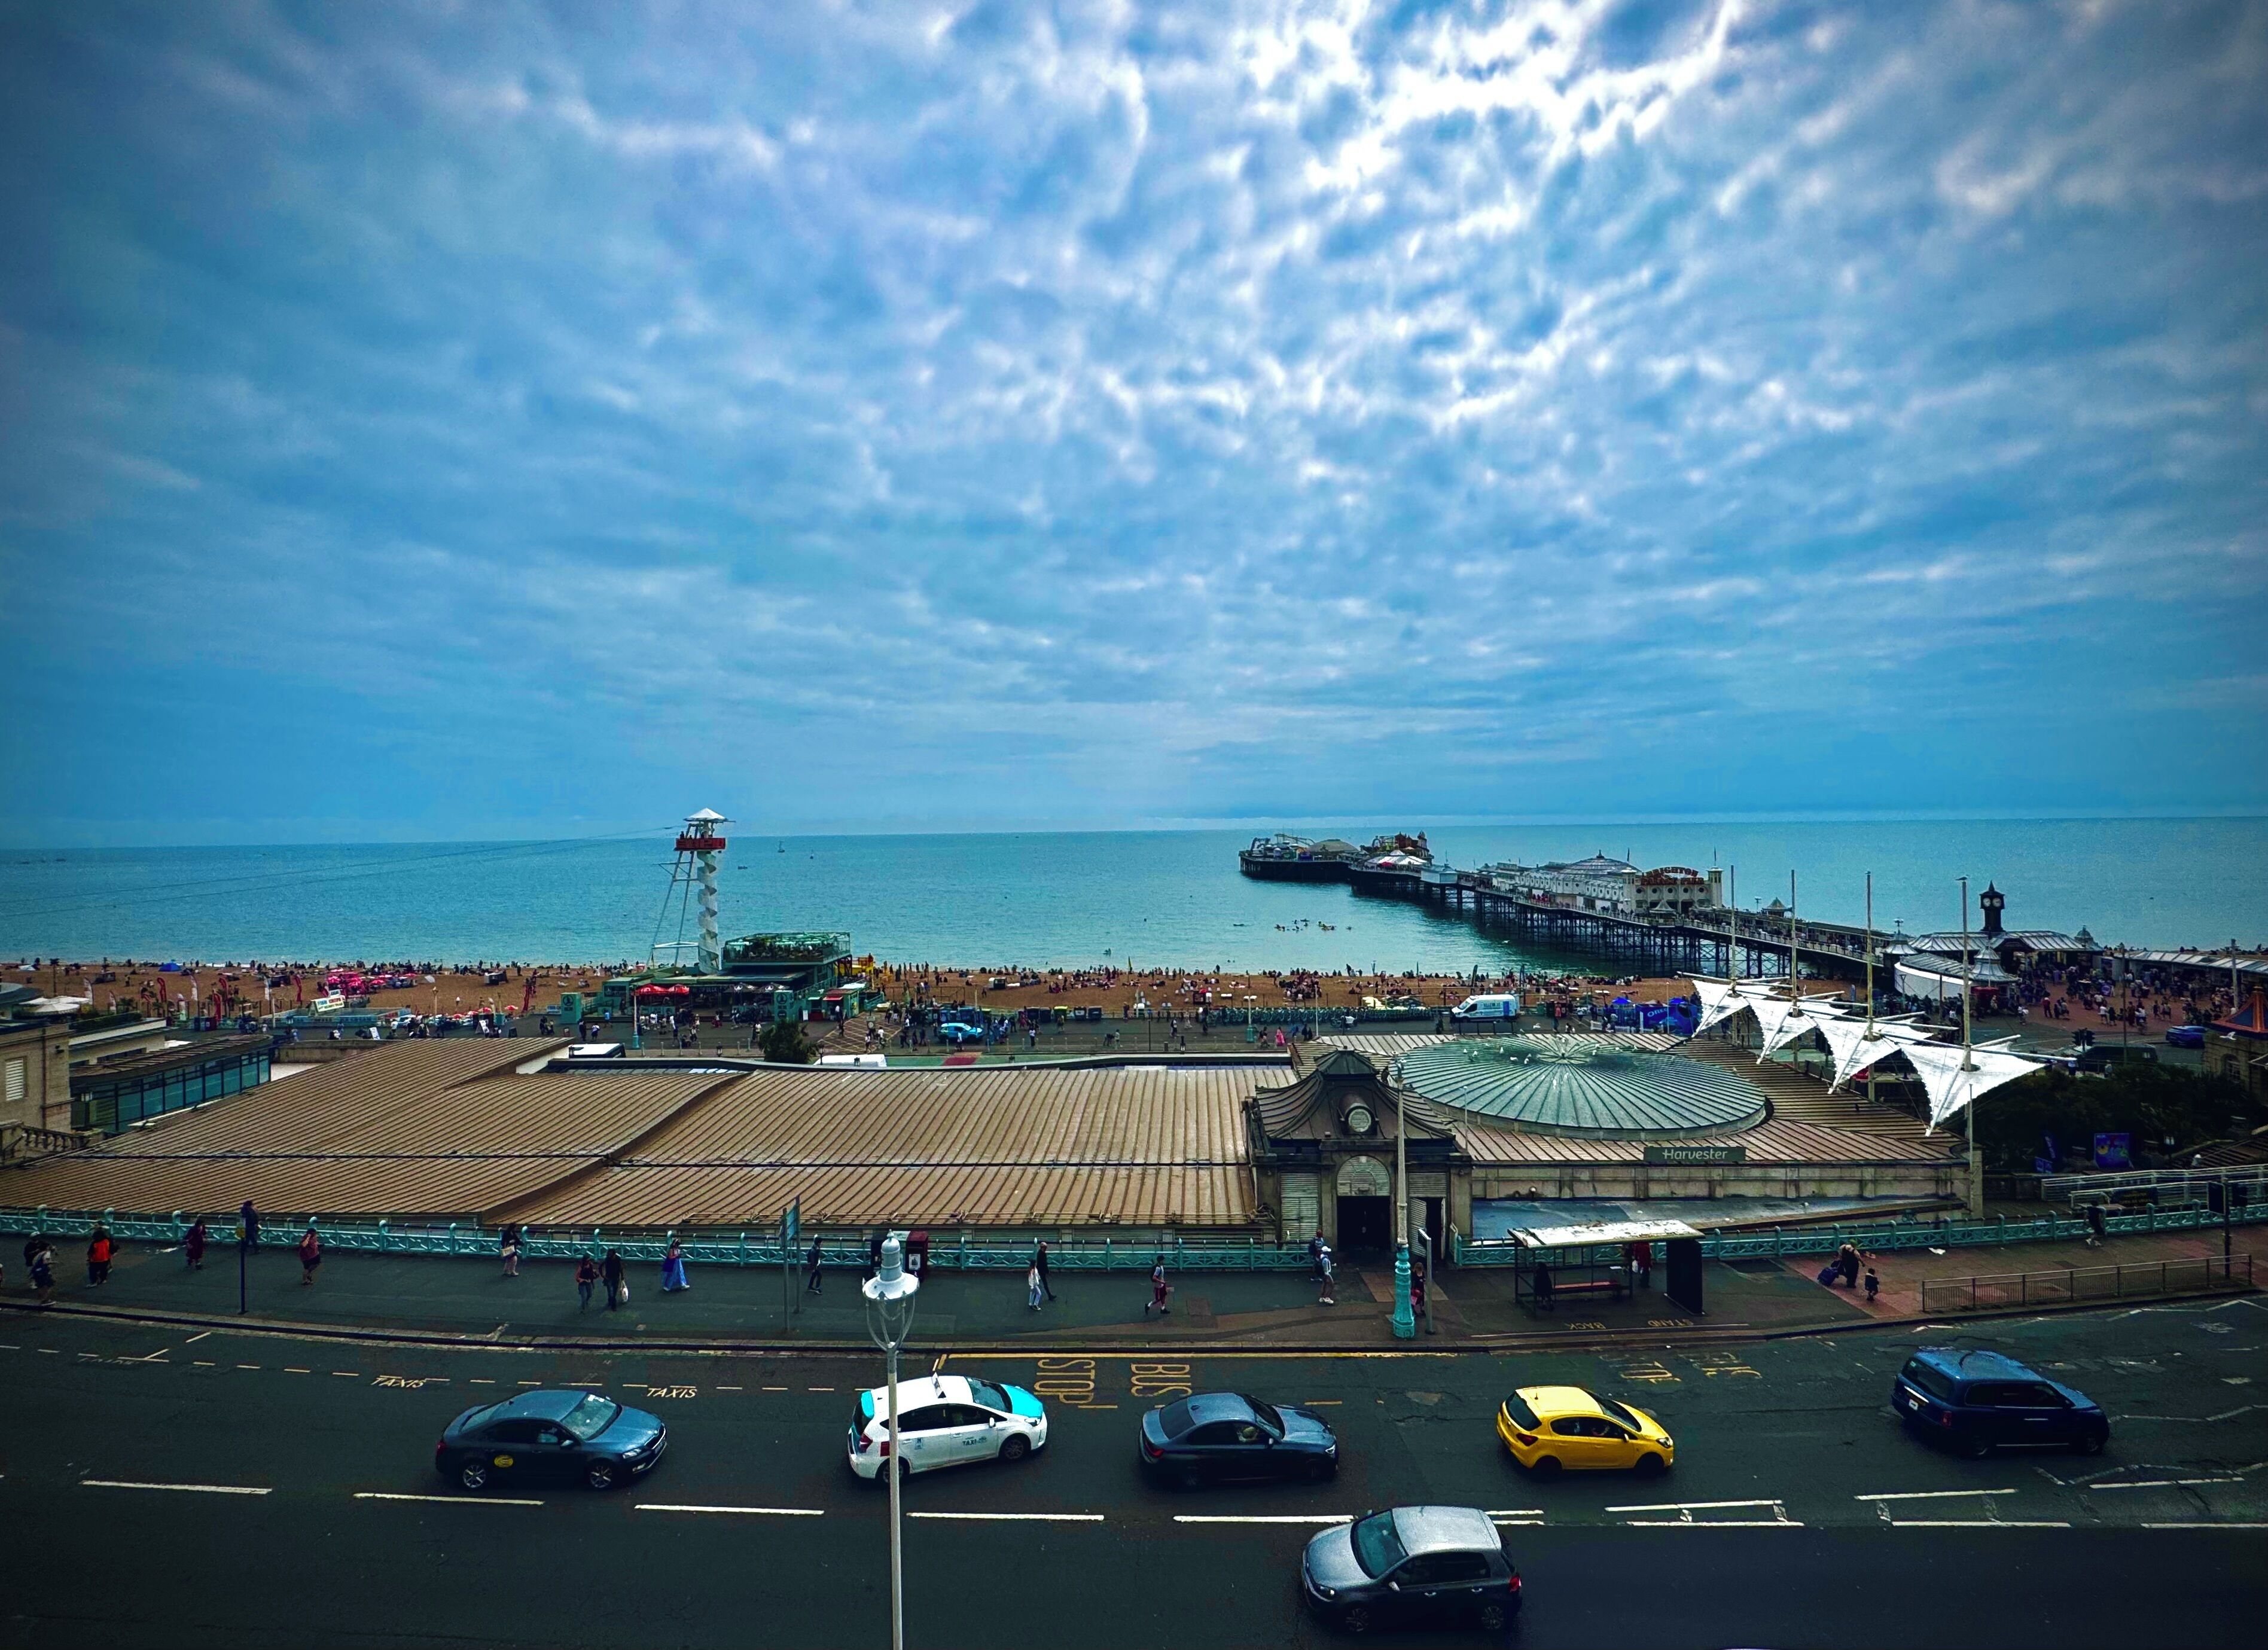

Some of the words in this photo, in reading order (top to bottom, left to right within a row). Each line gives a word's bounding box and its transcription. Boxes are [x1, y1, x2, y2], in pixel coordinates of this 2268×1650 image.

[1645, 867, 1699, 877] BRIGHTON
[1662, 1148, 1728, 1160] Harvester
[1565, 1322, 1606, 1331] BACK
[370, 1377, 427, 1389] TAXIS
[1033, 1358, 1096, 1404] STOP
[1130, 1363, 1193, 1397] BUS
[646, 1387, 698, 1398] TAXIS
